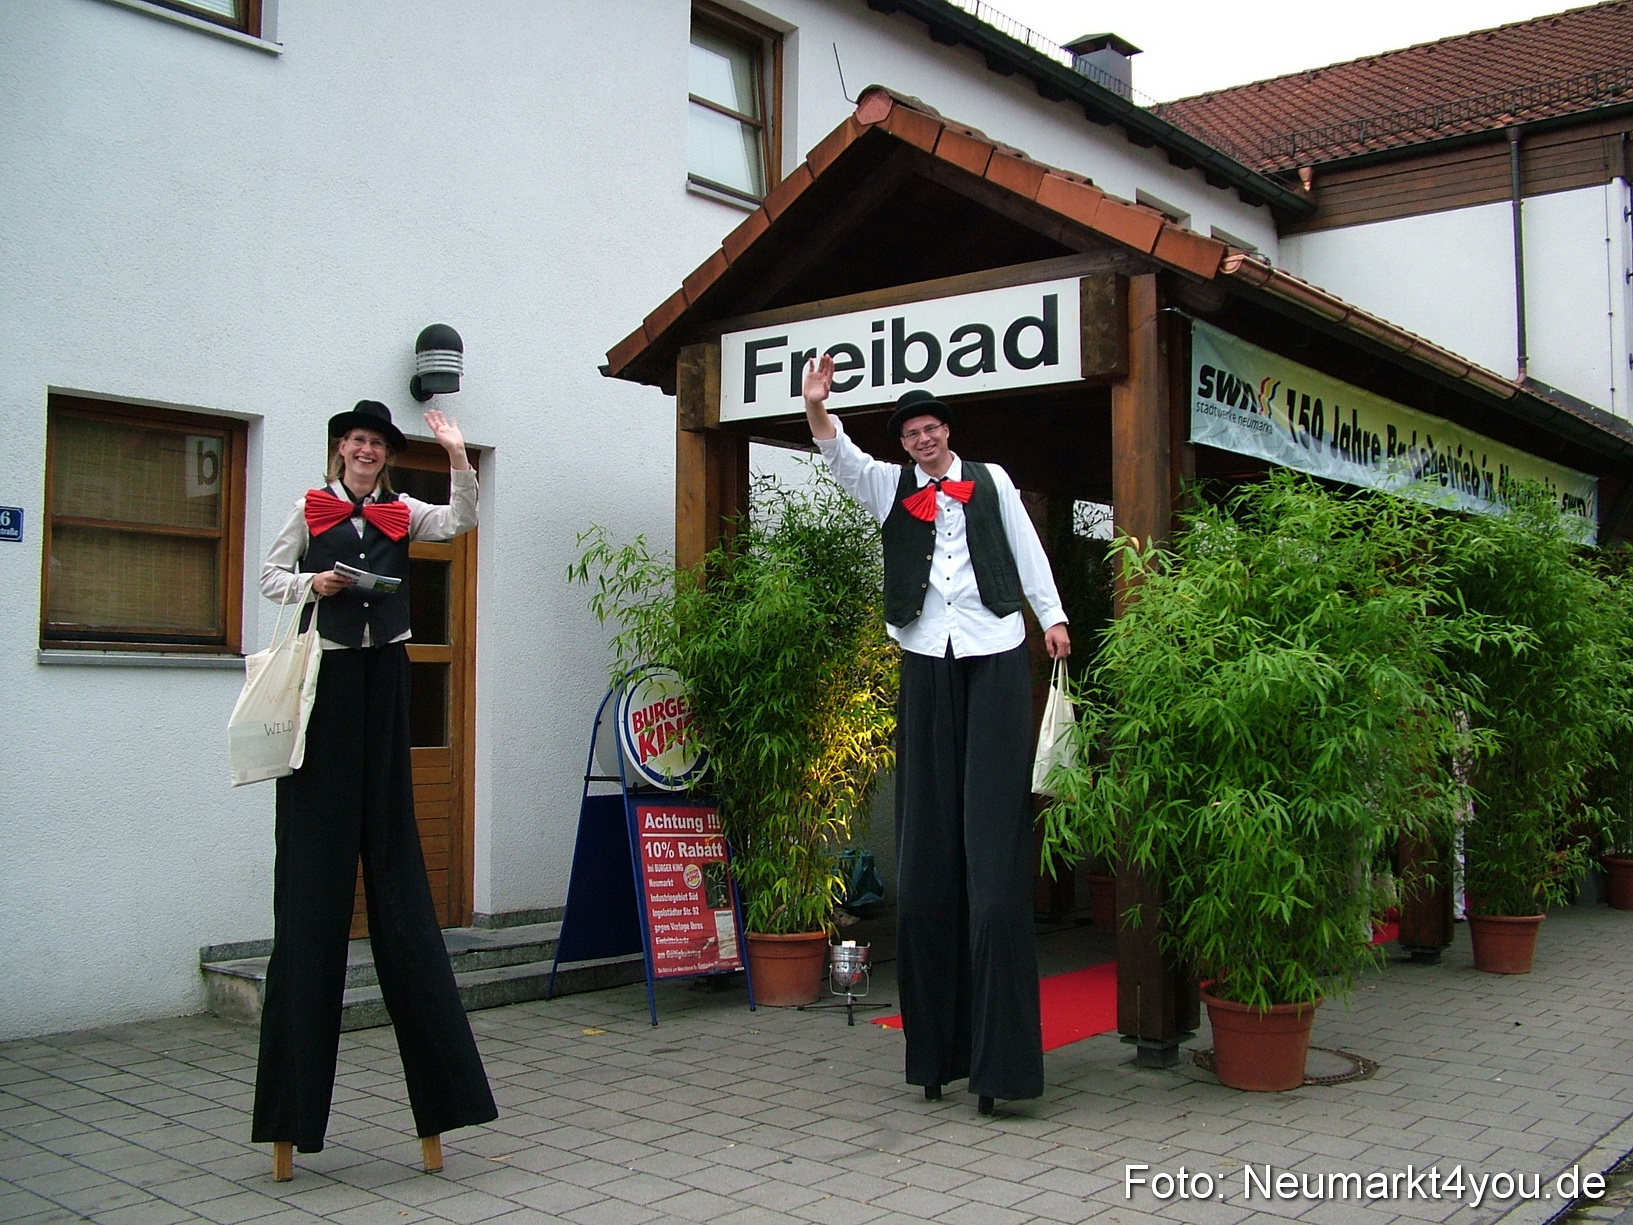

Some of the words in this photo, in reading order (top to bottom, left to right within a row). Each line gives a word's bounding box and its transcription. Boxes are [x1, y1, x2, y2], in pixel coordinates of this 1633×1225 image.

[744, 293, 1060, 405] Freibad
[1197, 364, 1258, 414] swn
[1196, 401, 1237, 424] stadtwerke
[1286, 388, 1324, 454] 150
[1329, 405, 1381, 470] Jahre
[0, 510, 11, 526] 6
[631, 693, 698, 735] BURGE
[263, 720, 294, 737] WILD
[644, 812, 704, 833] Achtung
[645, 841, 675, 858] 10%
[677, 841, 724, 858] Rabatt
[672, 863, 684, 872] KING
[648, 878, 674, 888] Neumarkt
[688, 892, 699, 901] Süd
[682, 907, 692, 916] Str.
